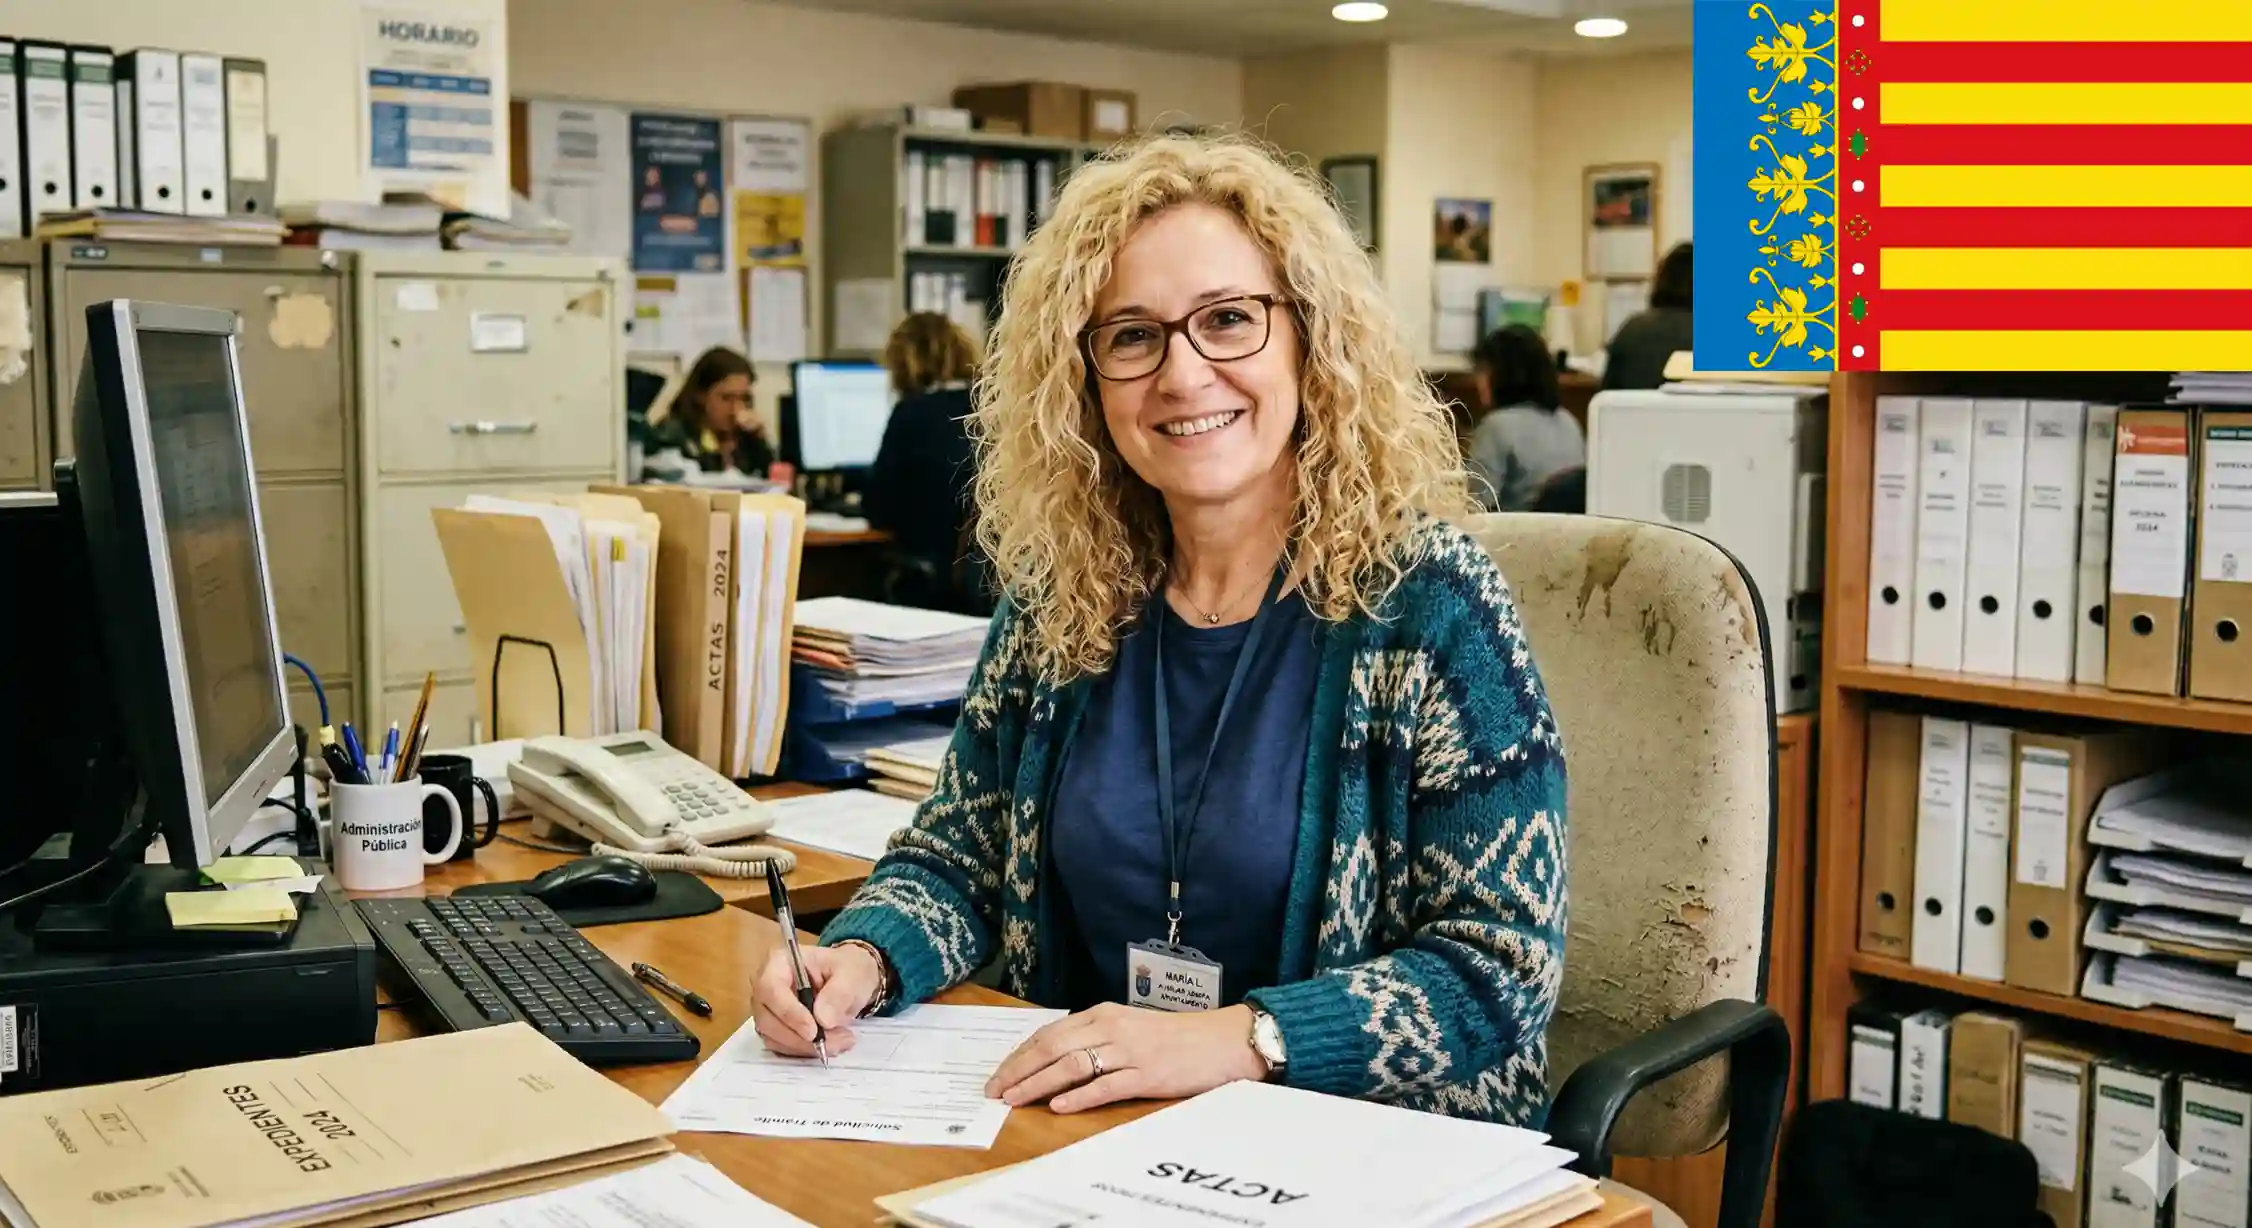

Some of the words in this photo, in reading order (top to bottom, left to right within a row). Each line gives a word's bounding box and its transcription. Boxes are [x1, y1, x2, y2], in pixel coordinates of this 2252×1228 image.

[379, 20, 480, 48] HORARIO
[713, 549, 727, 597] 2024
[708, 622, 724, 691] ACTAS
[362, 838, 407, 852] Pública
[1165, 972, 1194, 987] MARÍA
[222, 1084, 332, 1173] EXPEDIENTES
[302, 1109, 356, 1140] 2024
[812, 1119, 831, 1127] de
[1147, 1162, 1310, 1205] ACTAS
